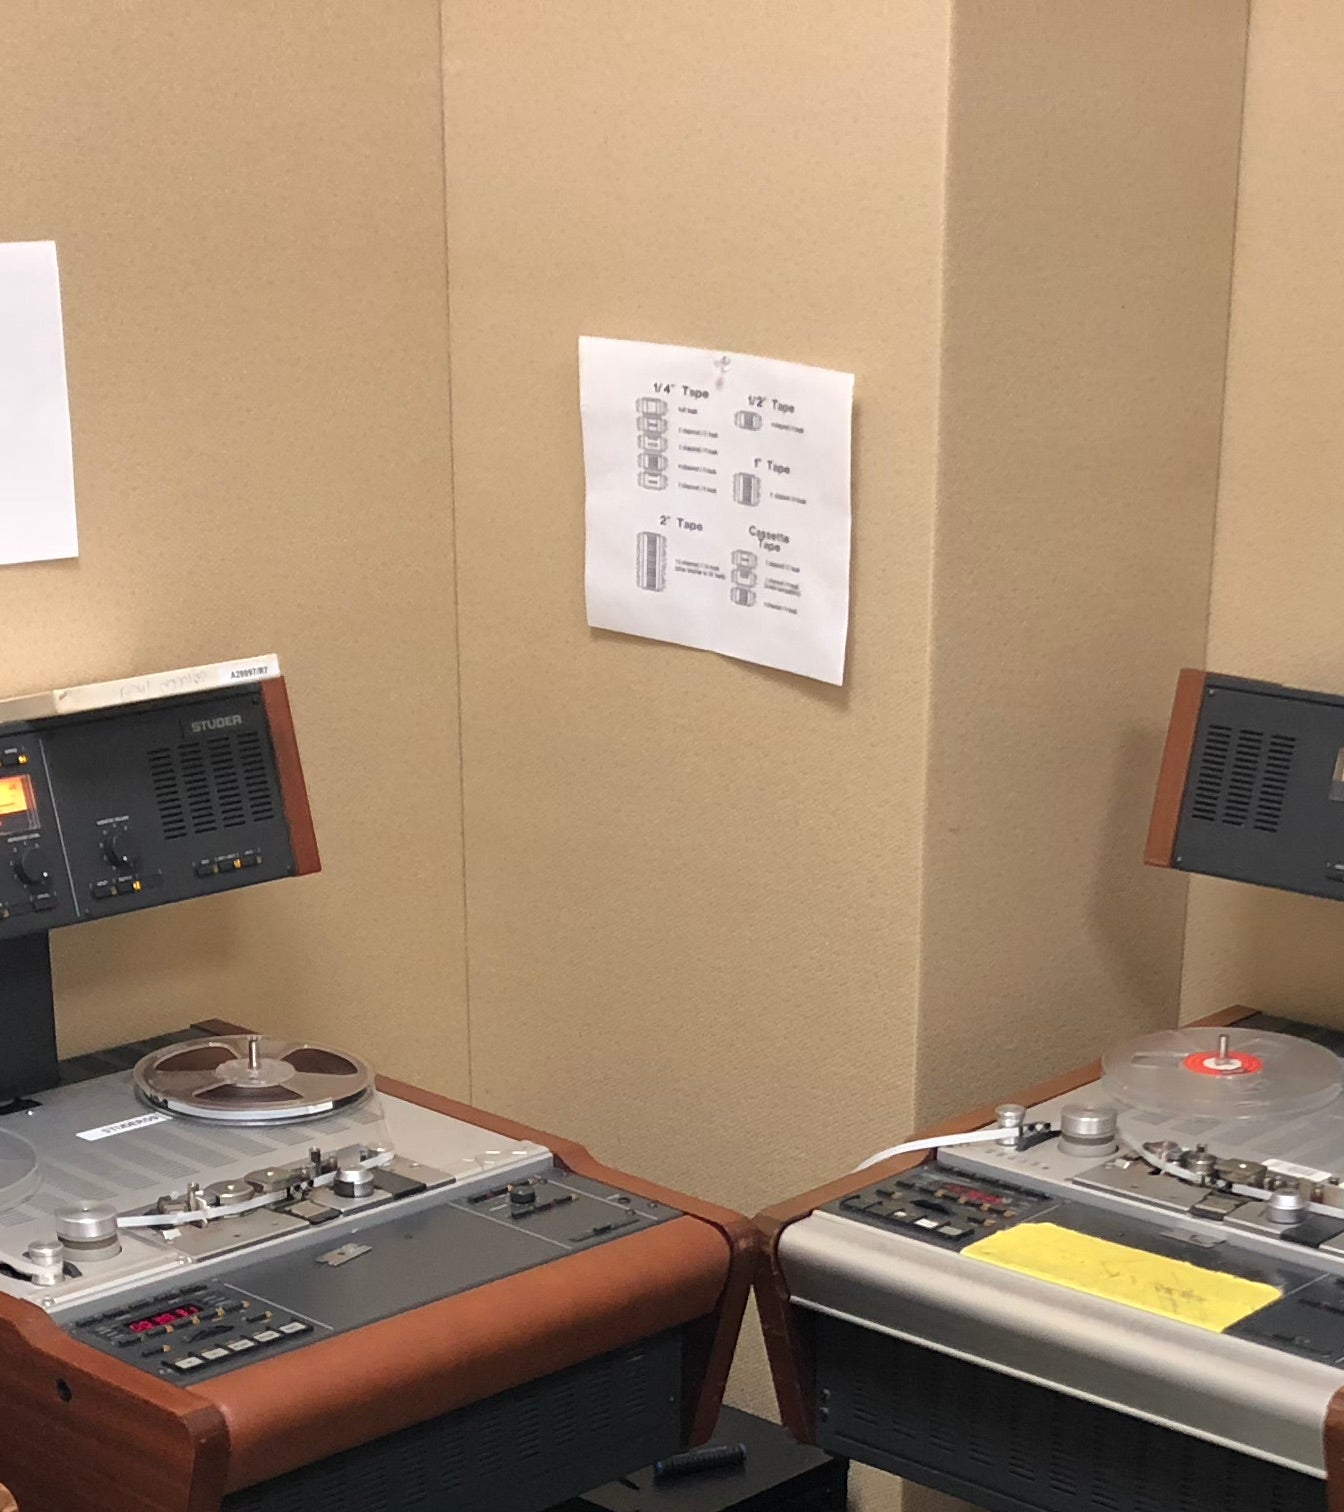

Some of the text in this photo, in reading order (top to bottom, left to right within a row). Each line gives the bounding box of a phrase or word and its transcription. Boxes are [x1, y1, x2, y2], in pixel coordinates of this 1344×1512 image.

[682, 385, 709, 399] Tape
[772, 399, 795, 414] Tape
[767, 460, 790, 475] Tape
[677, 517, 703, 532] Tape
[749, 525, 790, 544] Cassette
[758, 537, 781, 552] Tape
[191, 714, 242, 733] STUDER
